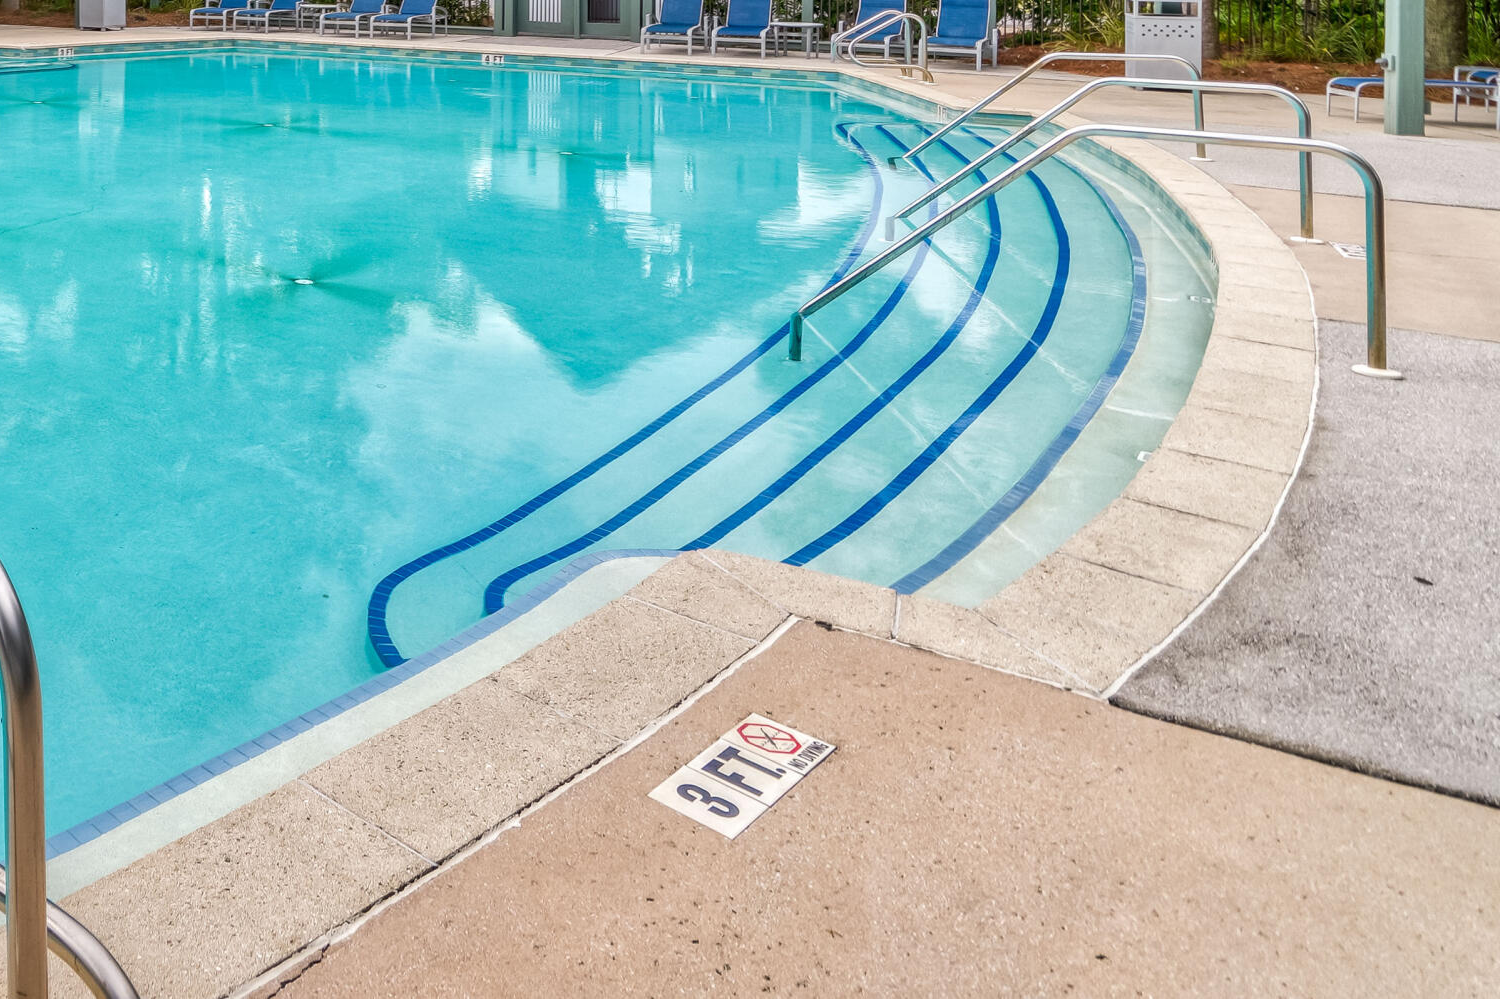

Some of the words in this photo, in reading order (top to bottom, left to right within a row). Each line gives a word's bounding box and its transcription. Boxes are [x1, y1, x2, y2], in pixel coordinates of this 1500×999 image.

[493, 55, 503, 63] FT
[797, 741, 830, 763] DIVING
[701, 745, 787, 797] FT.
[787, 758, 809, 771] NO
[676, 783, 740, 819] 3
